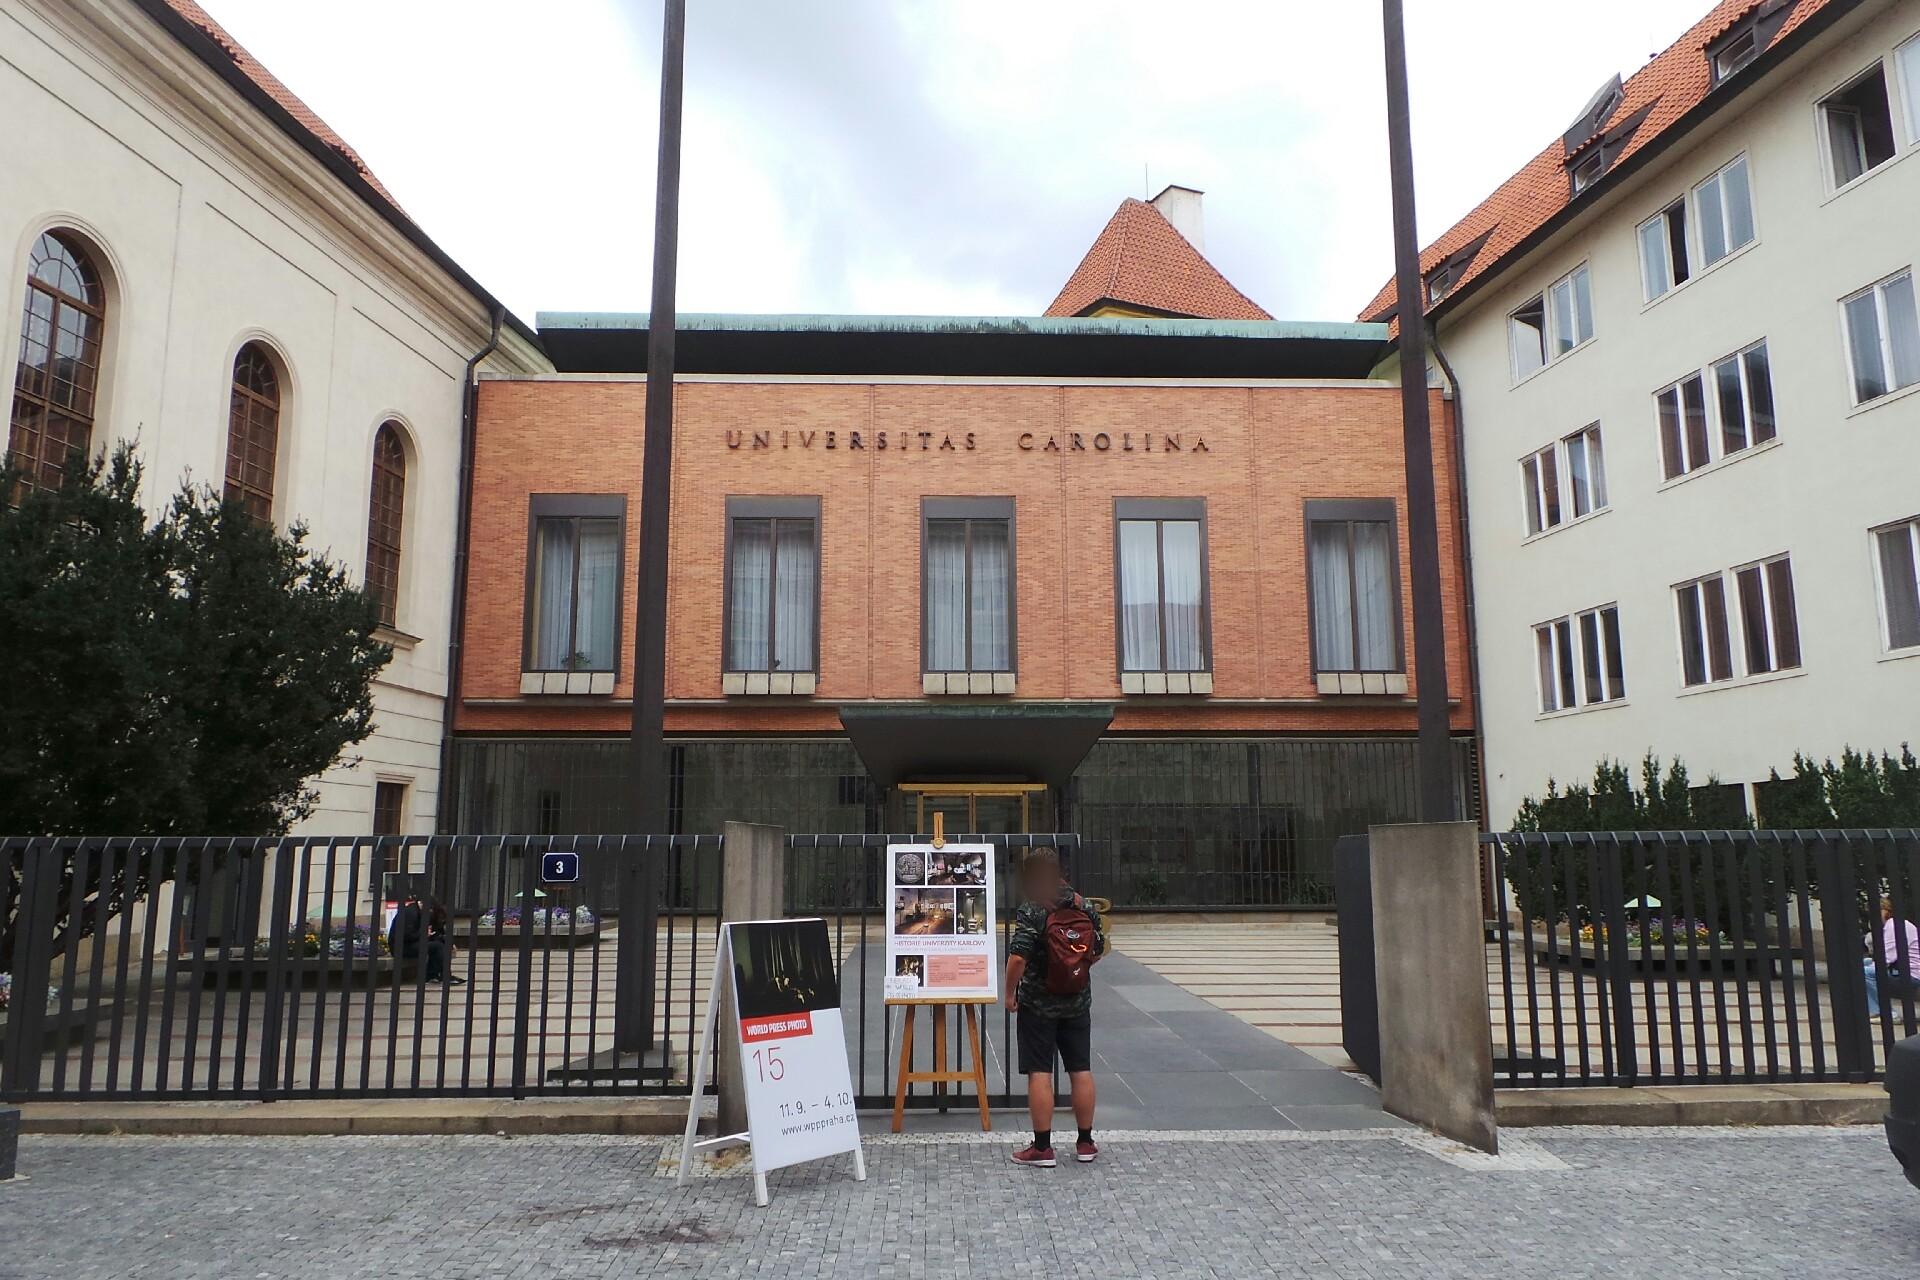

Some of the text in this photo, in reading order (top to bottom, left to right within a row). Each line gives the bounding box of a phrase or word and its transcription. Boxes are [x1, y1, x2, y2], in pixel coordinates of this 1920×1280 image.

[726, 430, 1209, 451] UNIVERSITAS CAROLINA
[555, 860, 564, 874] 3
[746, 1019, 807, 1036] WORLD PRESS PHOTO
[753, 1047, 785, 1082] 15
[780, 1104, 794, 1117] 11.
[796, 1101, 806, 1114] 9.
[824, 1096, 834, 1109] 4.
[837, 1092, 853, 1107] 10.
[782, 1114, 855, 1135] www.wpppraha.cz
